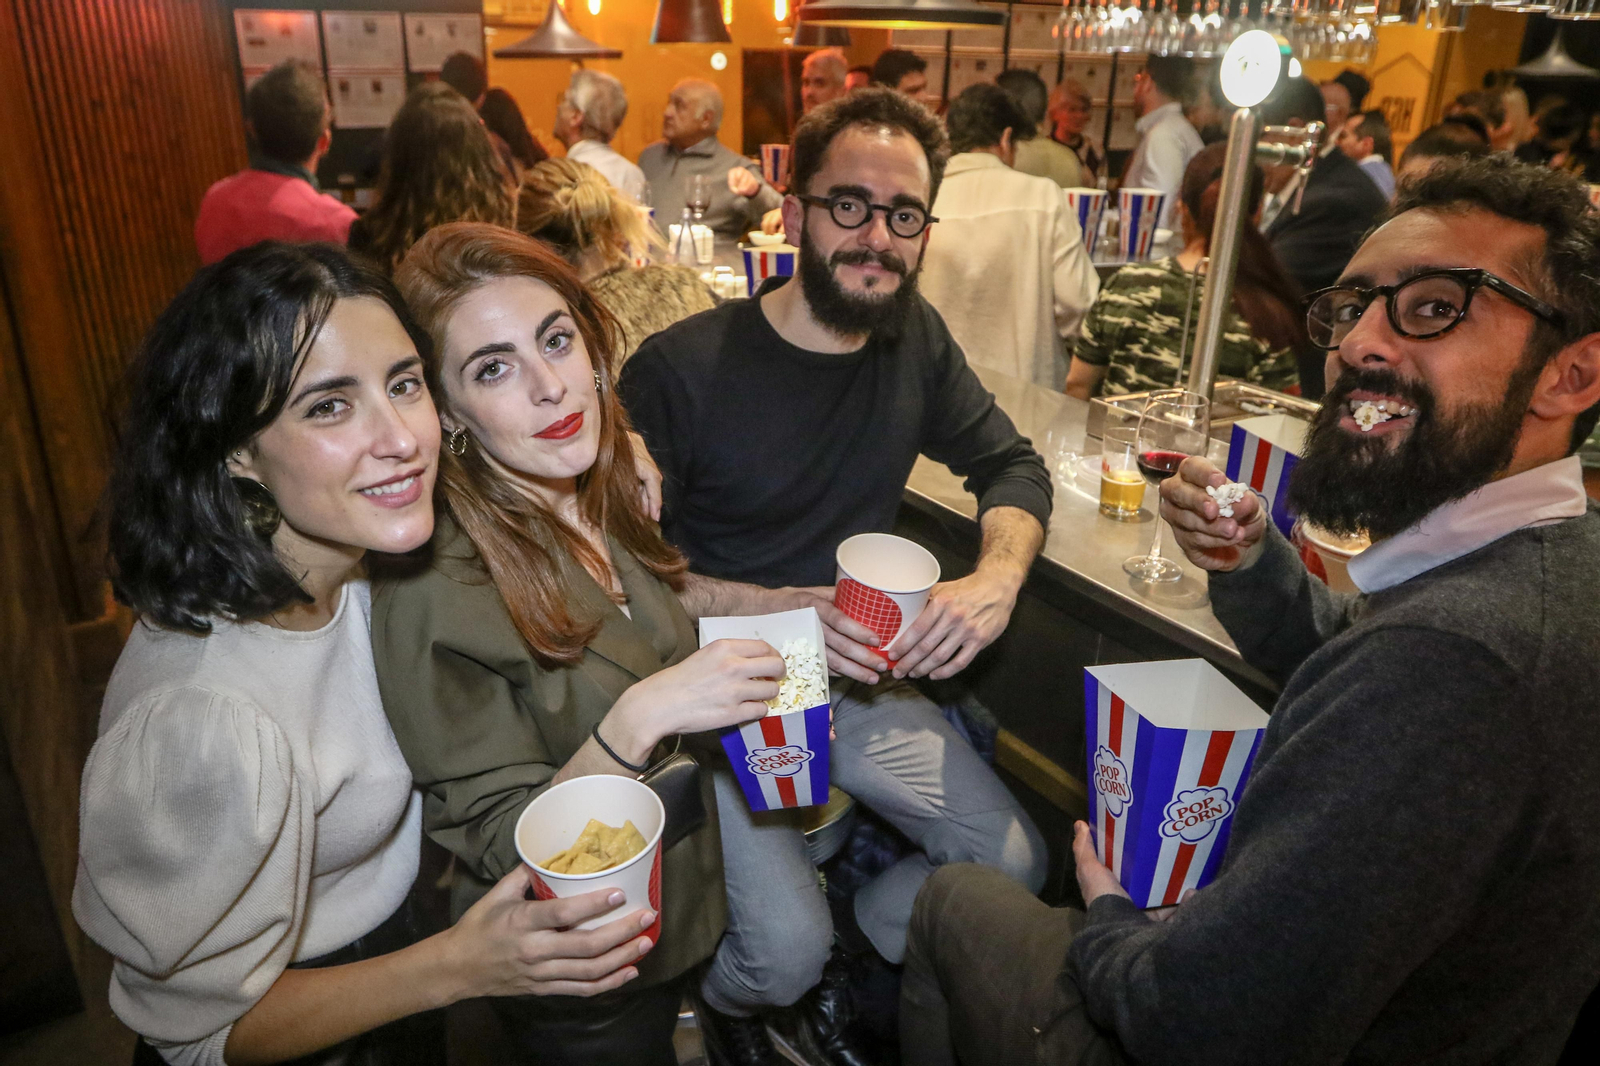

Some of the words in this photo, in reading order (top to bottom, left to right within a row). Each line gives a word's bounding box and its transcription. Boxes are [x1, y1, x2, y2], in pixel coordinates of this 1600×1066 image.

[758, 751, 790, 765] POP
[760, 754, 804, 771] CORN
[1100, 764, 1120, 781] POP
[1099, 777, 1127, 797] CORN
[1176, 797, 1214, 819] POP
[1172, 804, 1223, 832] CORN
